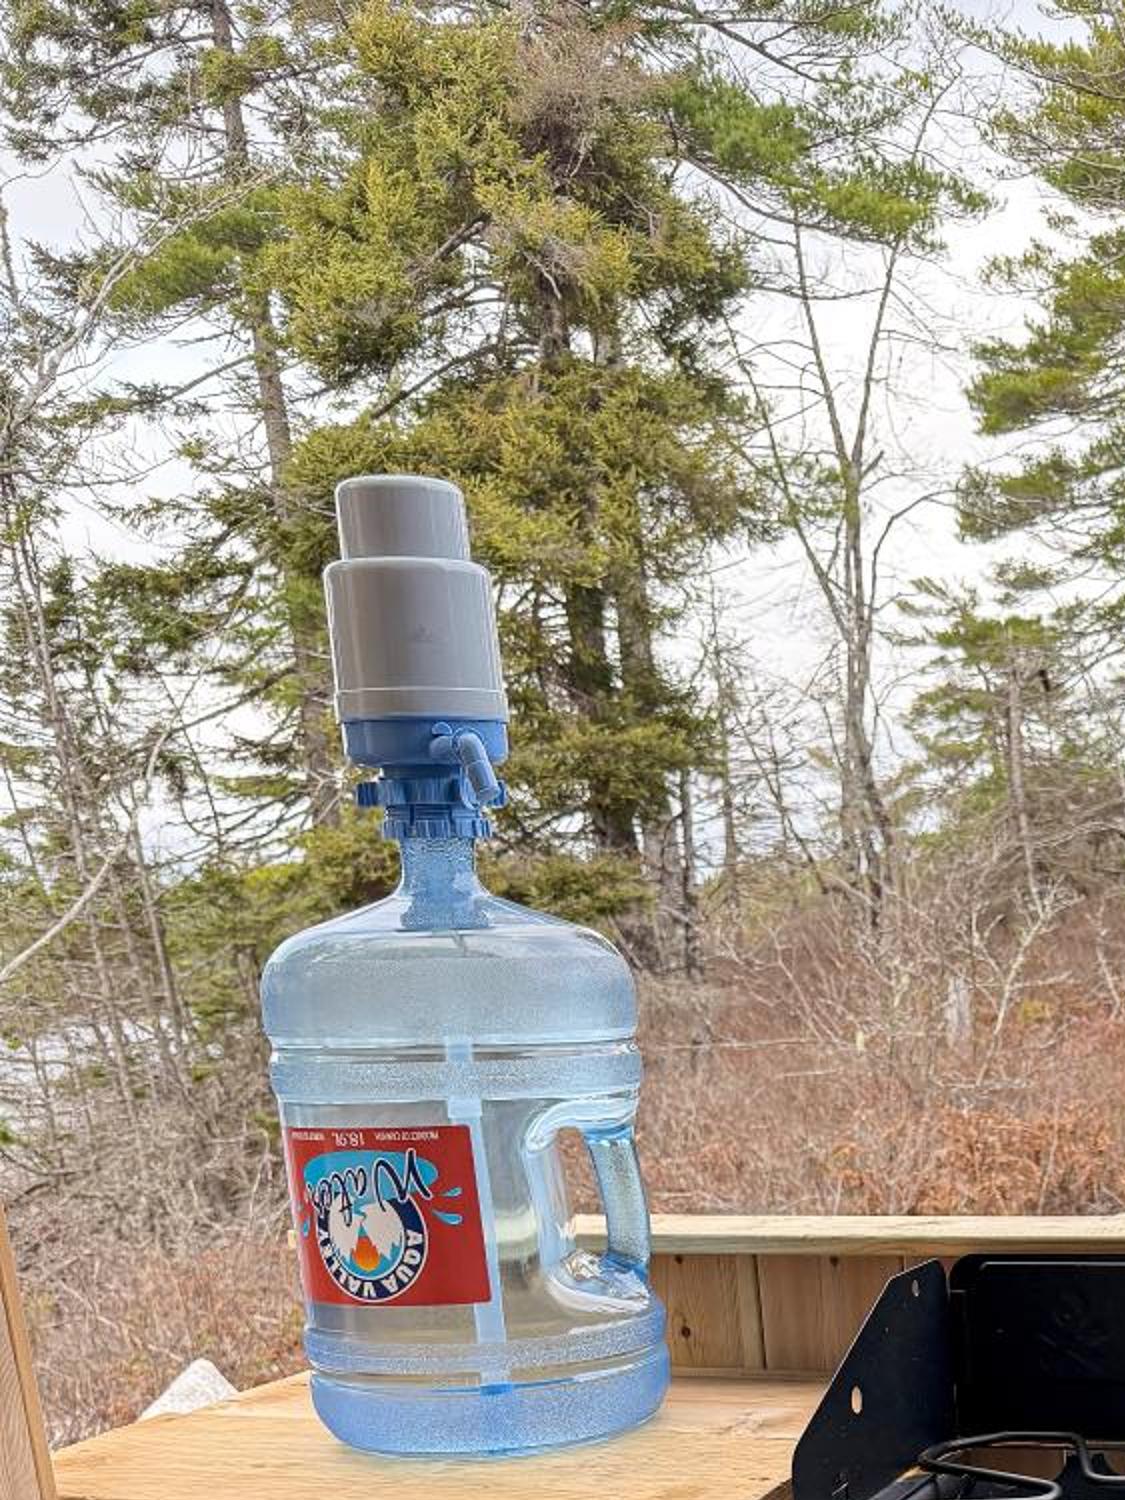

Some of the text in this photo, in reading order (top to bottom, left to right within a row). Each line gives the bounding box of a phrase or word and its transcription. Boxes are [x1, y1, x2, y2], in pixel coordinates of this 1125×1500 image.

[304, 1148, 433, 1227] Water
[316, 1228, 424, 1298] AQUA VALLEY
